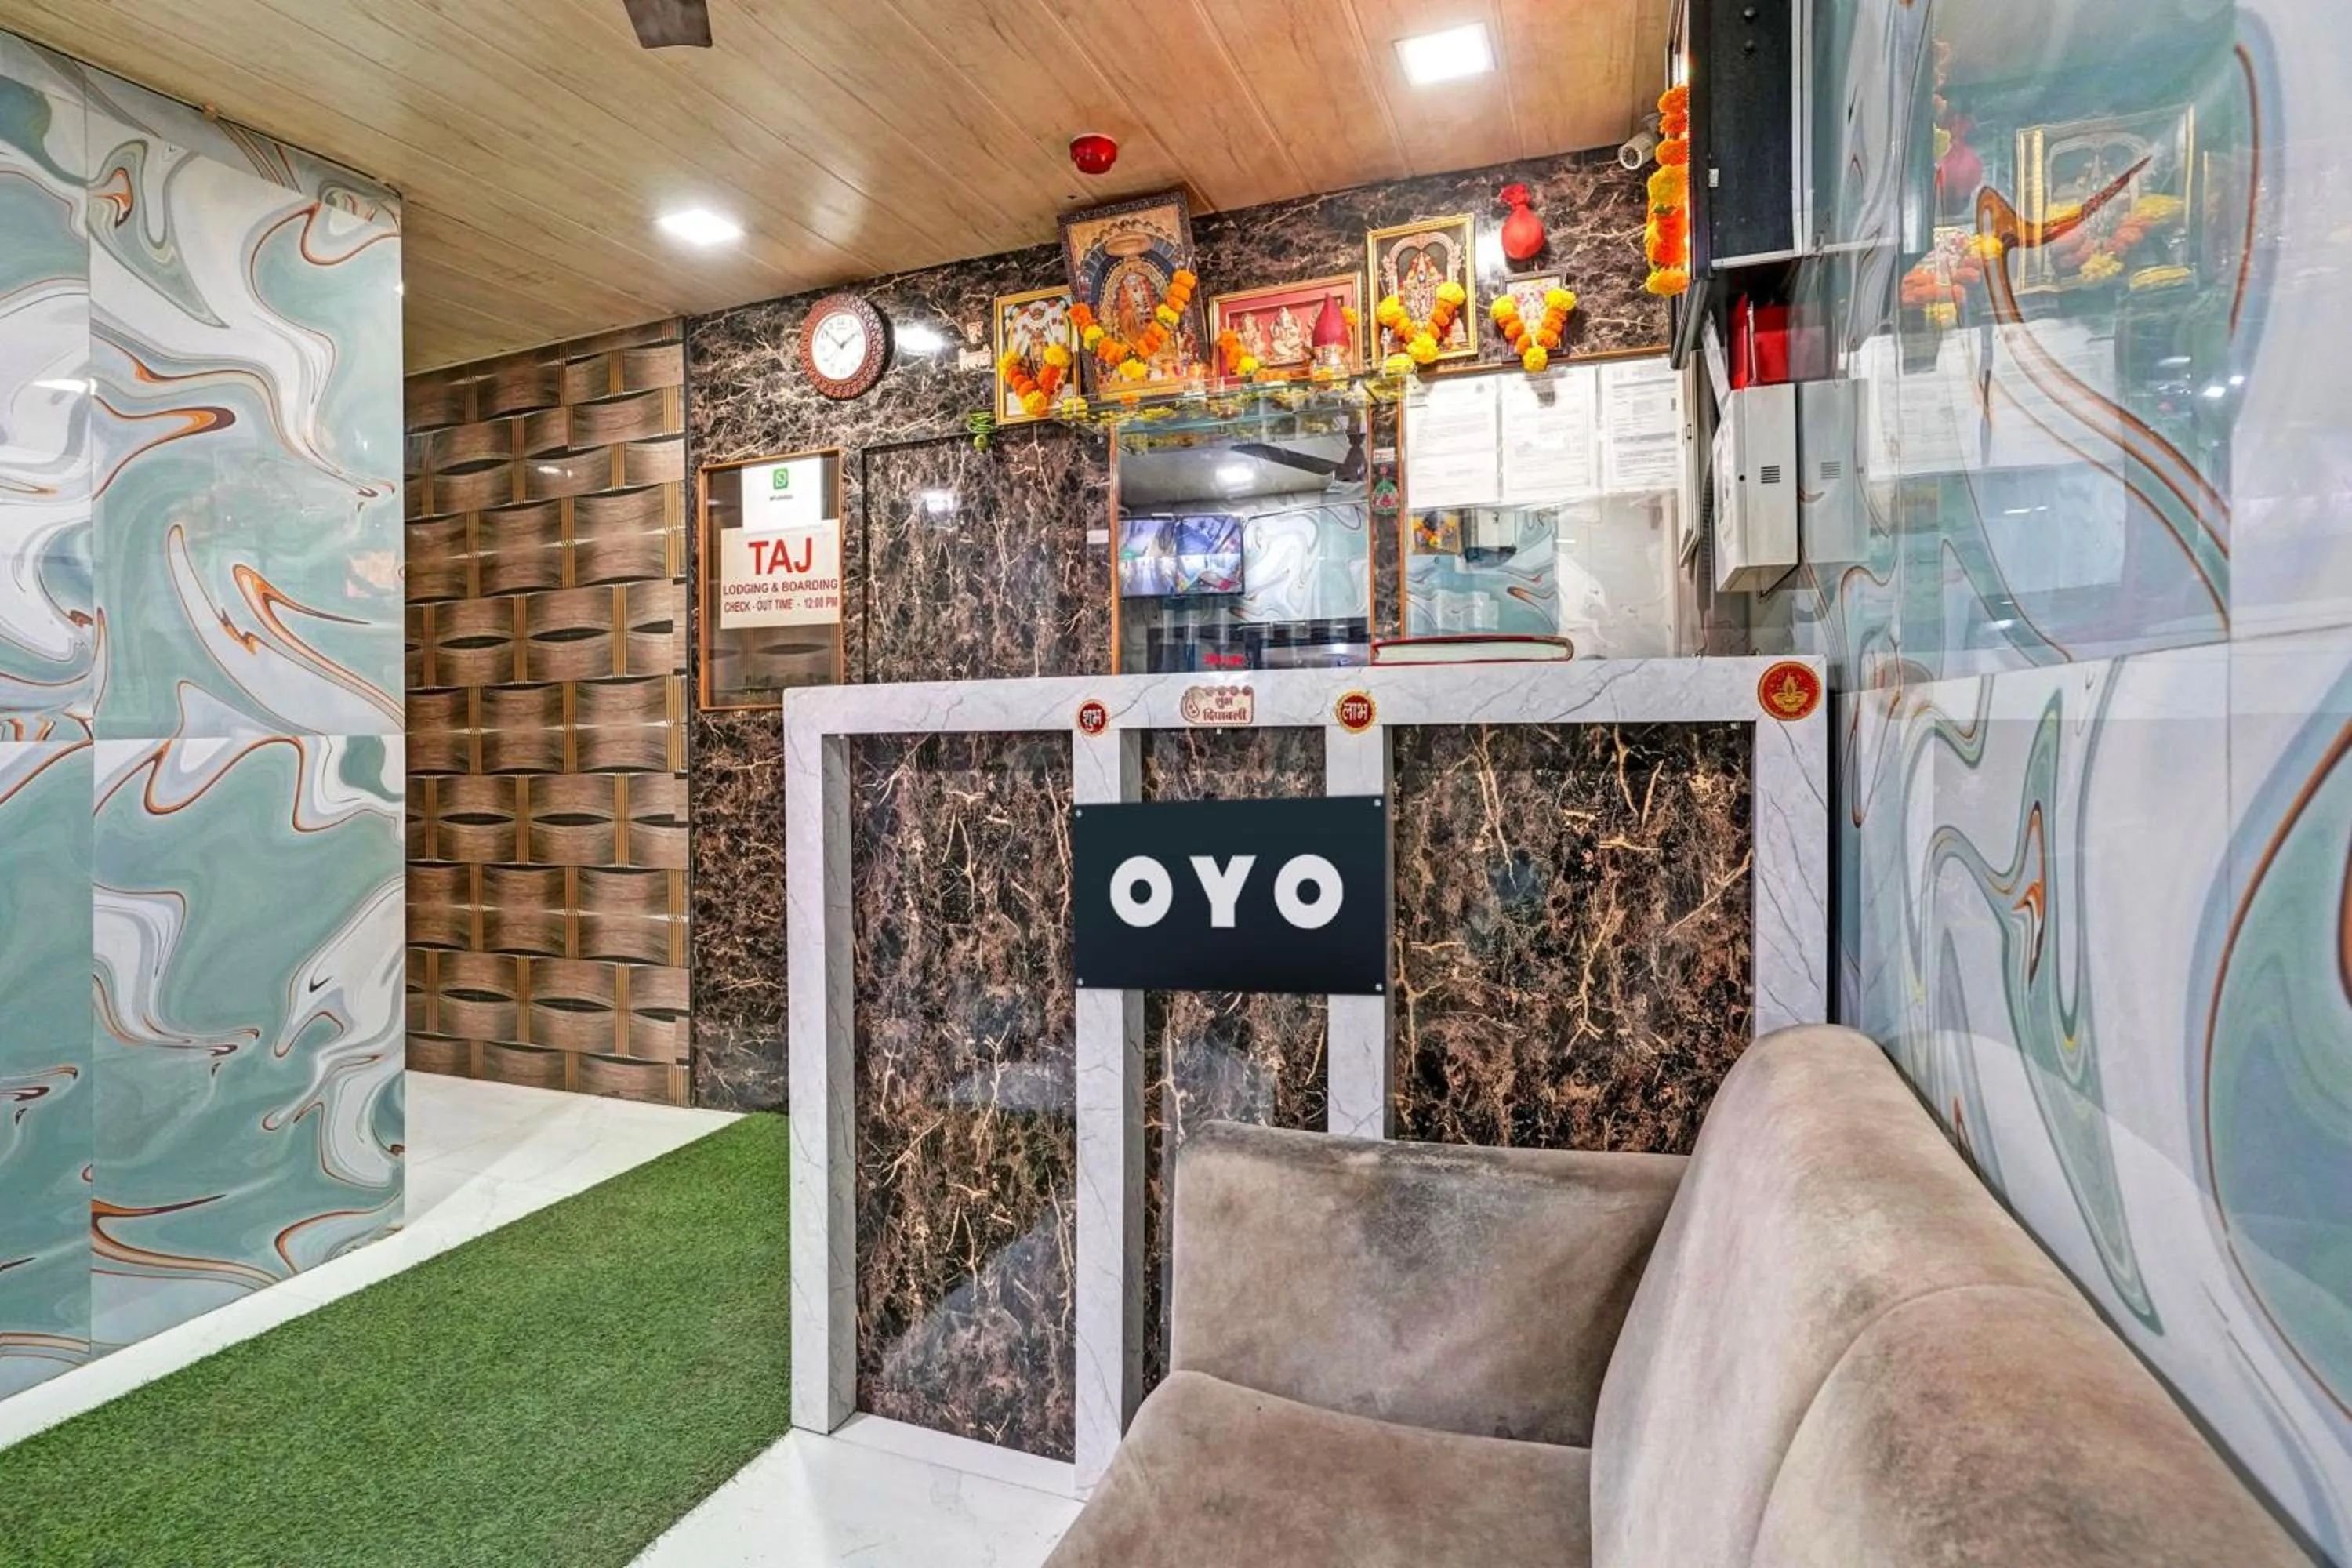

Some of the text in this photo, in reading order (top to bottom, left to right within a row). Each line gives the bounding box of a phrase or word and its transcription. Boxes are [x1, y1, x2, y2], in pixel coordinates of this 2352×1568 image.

[748, 537, 812, 575] TAJ
[723, 579, 838, 595] LODGING & BOARDING
[775, 598, 793, 609] TIME
[826, 596, 838, 608] PM
[1083, 709, 1102, 731] शुभ
[1342, 702, 1368, 720] लाभ
[1109, 853, 1344, 929] OYO
